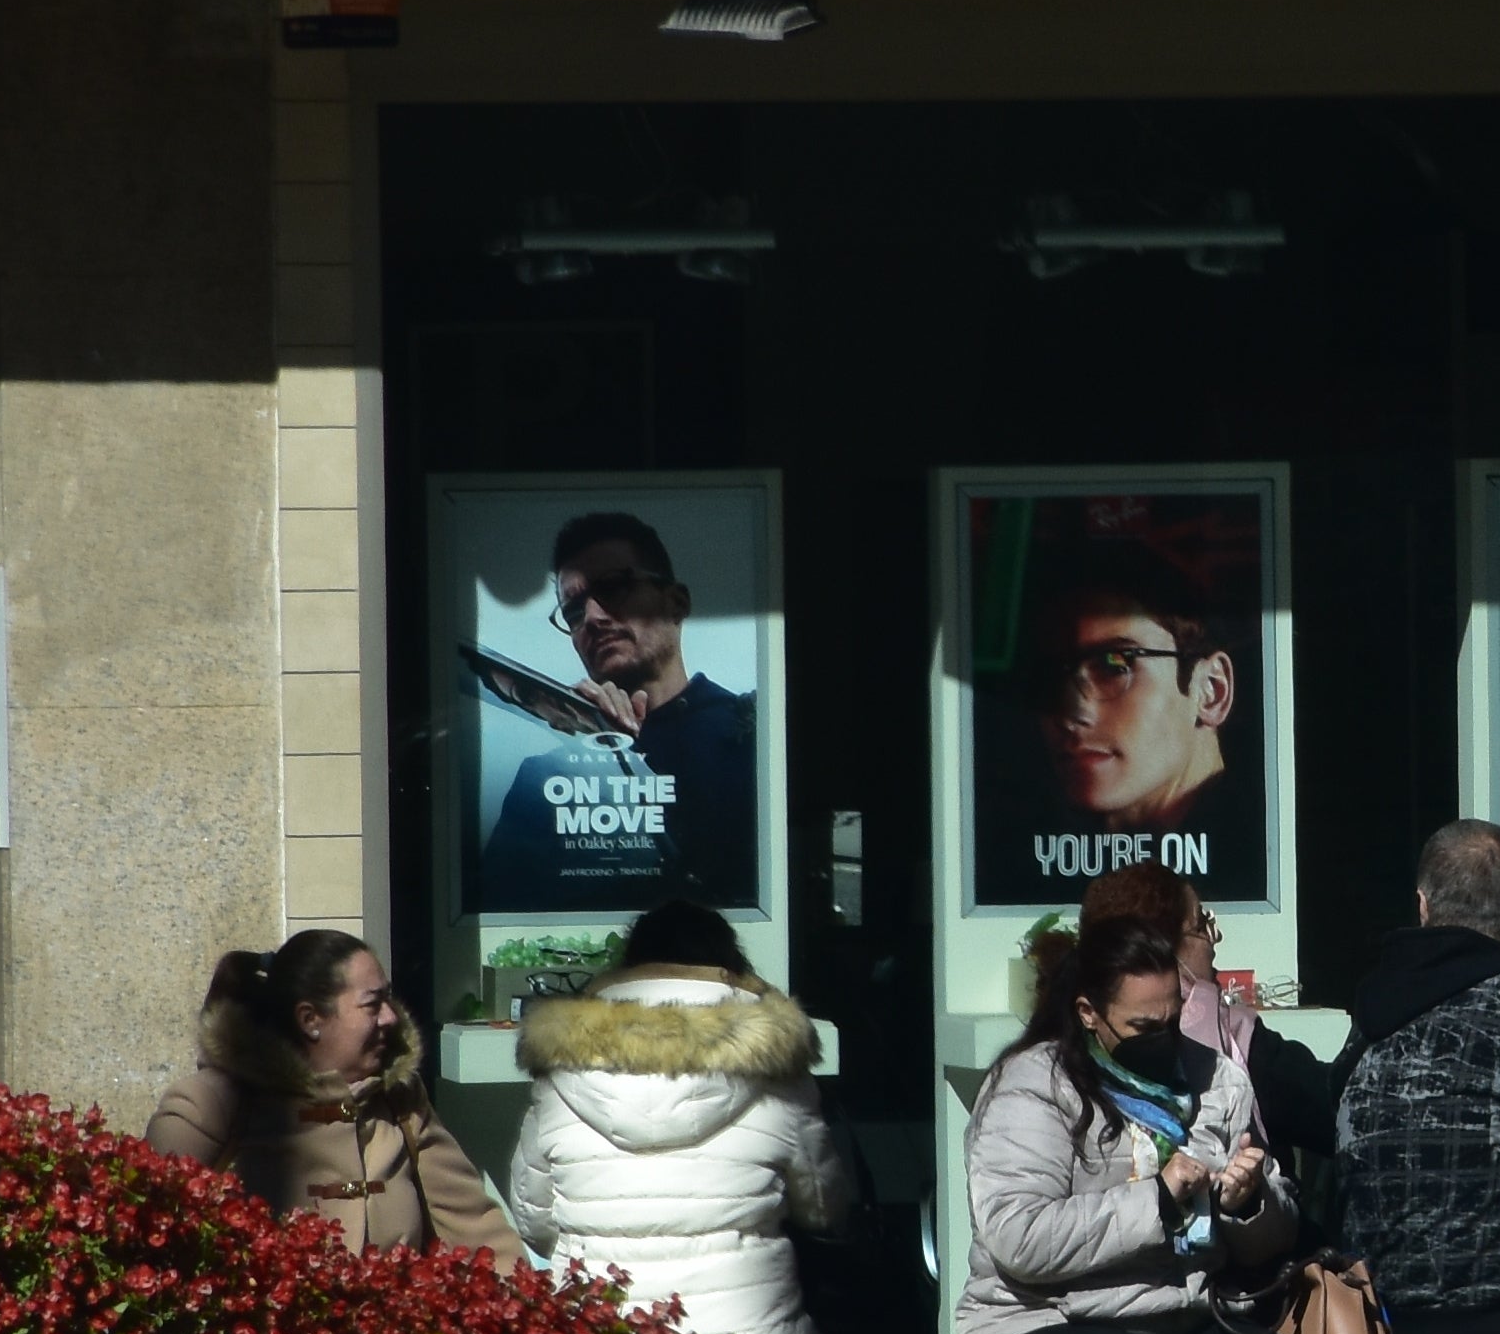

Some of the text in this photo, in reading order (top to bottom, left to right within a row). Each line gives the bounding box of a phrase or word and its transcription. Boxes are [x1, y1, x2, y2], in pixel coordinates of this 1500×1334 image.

[543, 775, 677, 804] ON THE
[555, 805, 666, 835] MOVE
[564, 838, 576, 850] in
[577, 836, 615, 853] Oakley
[1160, 832, 1208, 875] ON
